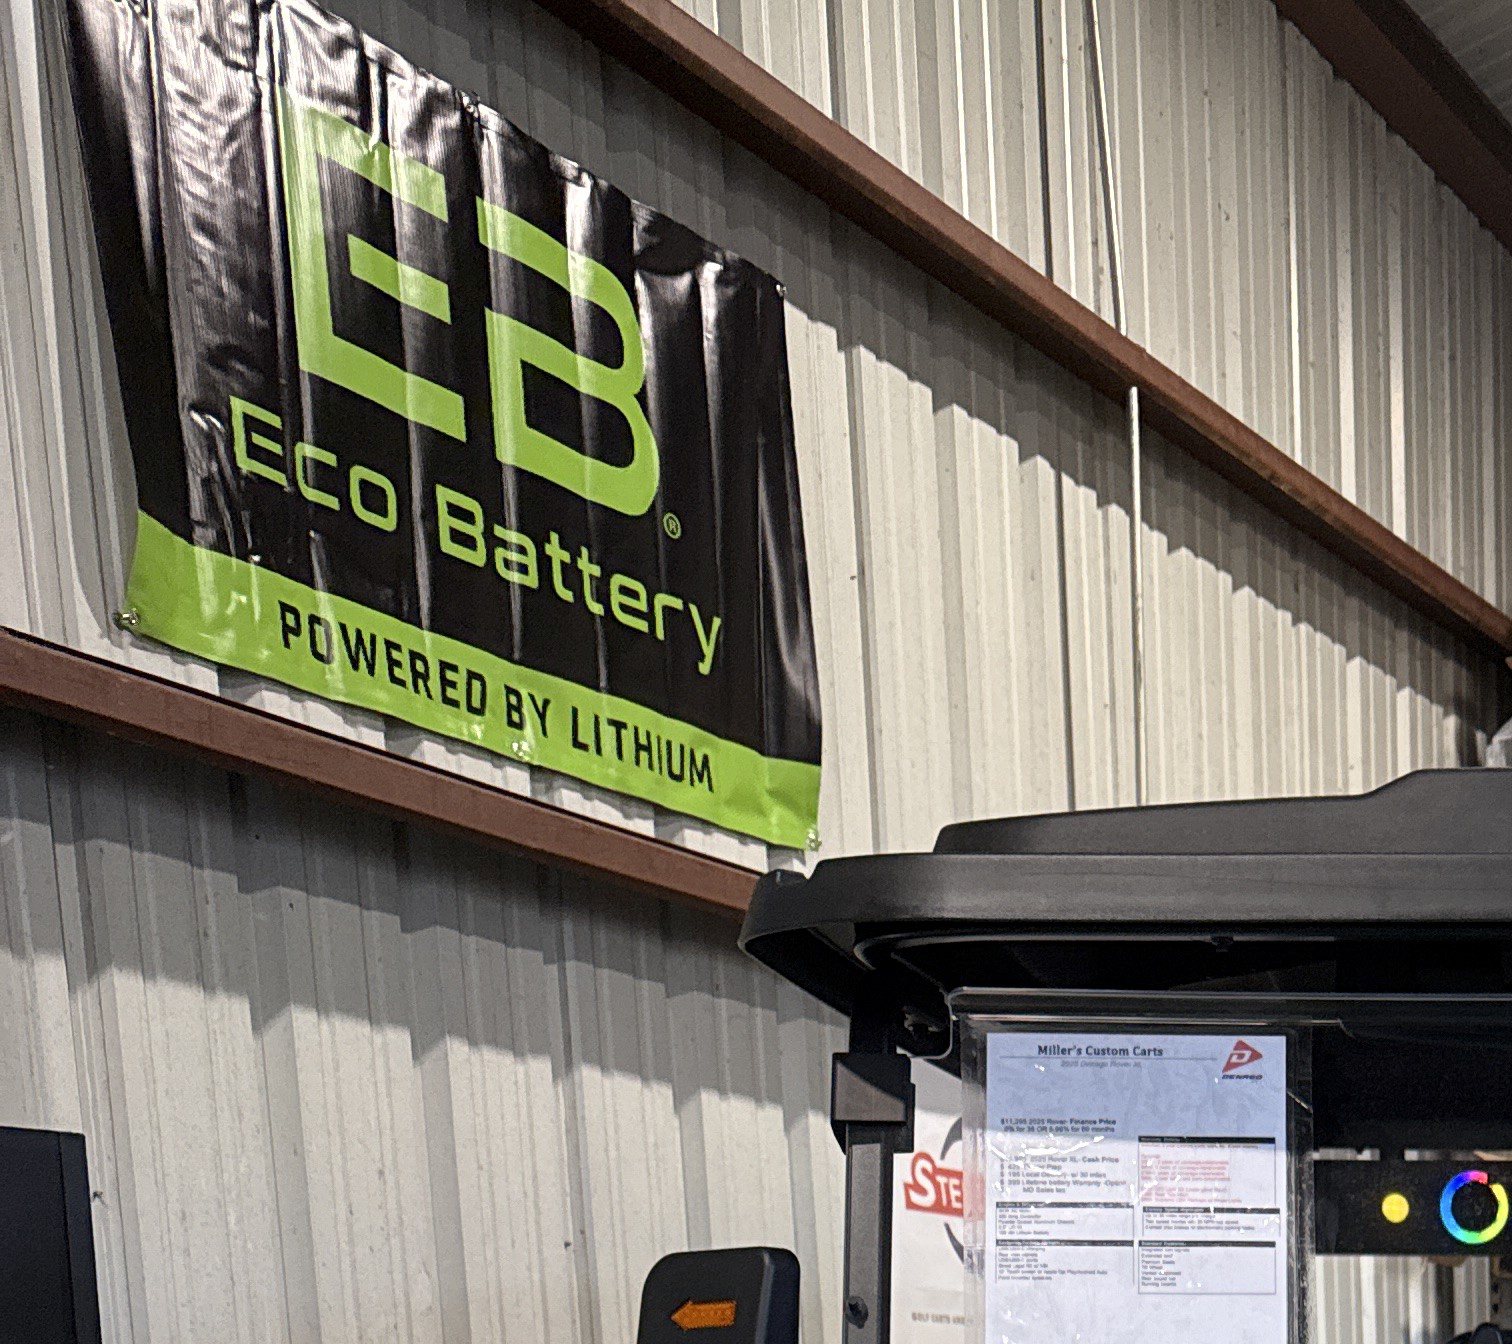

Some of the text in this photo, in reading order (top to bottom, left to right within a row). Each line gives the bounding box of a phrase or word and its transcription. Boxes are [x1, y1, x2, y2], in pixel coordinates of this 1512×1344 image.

[279, 86, 660, 517] EB
[231, 395, 723, 675] Eco Battery
[280, 600, 714, 793] POWERED BY LITHIUM
[1037, 1045, 1164, 1057] Miller's Custom Carts
